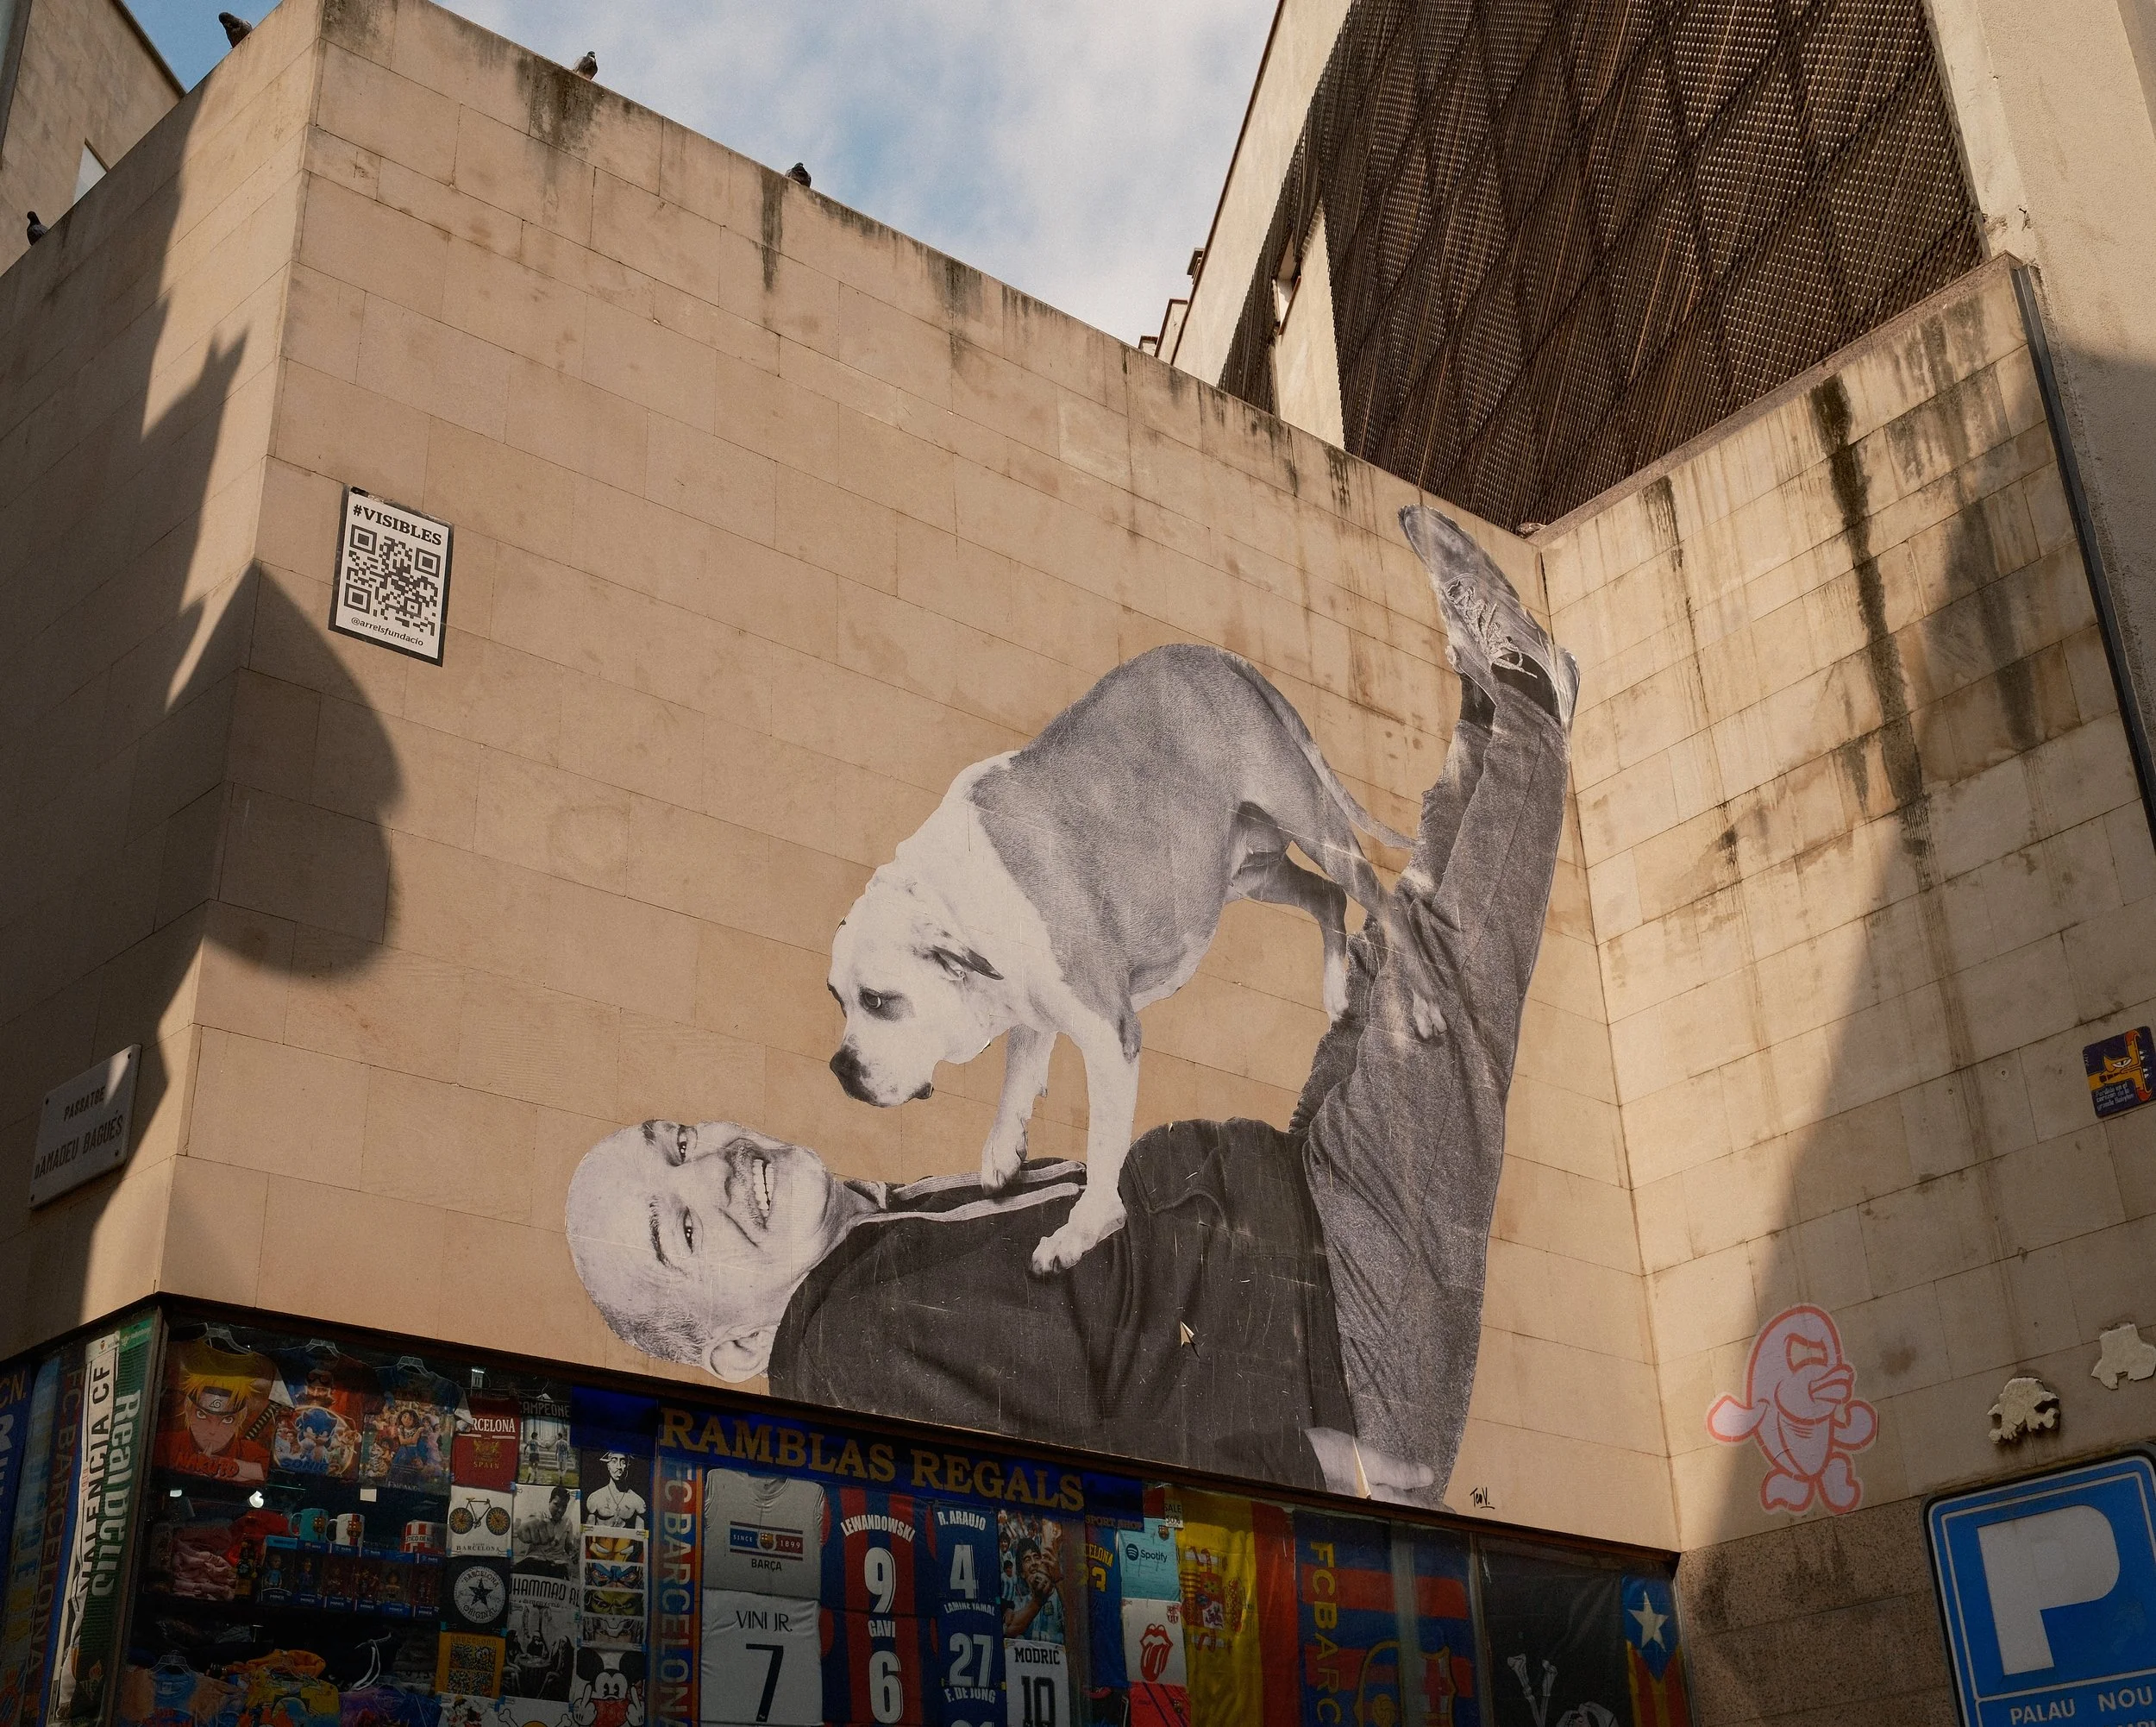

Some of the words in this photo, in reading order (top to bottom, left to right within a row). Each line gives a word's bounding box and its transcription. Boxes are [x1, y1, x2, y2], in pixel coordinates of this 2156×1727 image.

[353, 504, 442, 546] #VISIBLES
[350, 616, 424, 647] @arrelsfundacio
[64, 1086, 106, 1121] PASSATGE
[82, 1109, 123, 1154] BAGUÉS
[92, 1366, 110, 1405] CF
[107, 1389, 141, 1485] Real
[473, 1460, 500, 1469] SPAIN
[660, 1405, 898, 1484] RAMBLAS
[910, 1448, 1087, 1512] REGALS
[664, 1462, 693, 1504] FC
[937, 1510, 949, 1526] R.
[950, 1510, 987, 1531] ARAUJO
[1164, 1504, 1181, 1514] SALE
[732, 1534, 754, 1543] SINCE
[780, 1539, 801, 1549] 1899
[840, 1514, 915, 1542] LEWANDOWSKI
[751, 1558, 782, 1573] BARÇA
[950, 1543, 980, 1600] 4
[1140, 1549, 1168, 1563] Spotify
[463, 1569, 500, 1588] BARCELONA
[863, 1547, 897, 1614] 9
[1976, 1504, 2122, 1676] P
[462, 1604, 499, 1620] ORIGINAL
[736, 1610, 768, 1630] VINI
[971, 1602, 995, 1617] YAMAL
[868, 1619, 896, 1638] GAVI
[949, 1631, 993, 1687] 27
[1014, 1645, 1060, 1665] MODRIĆ
[745, 1643, 784, 1723] 7
[868, 1649, 904, 1725] 6
[943, 1688, 955, 1704] F.
[954, 1686, 968, 1699] DE
[1020, 1675, 1056, 1727] 10
[2009, 1698, 2076, 1725] PALAU
[2096, 1685, 2153, 1712] NOU
